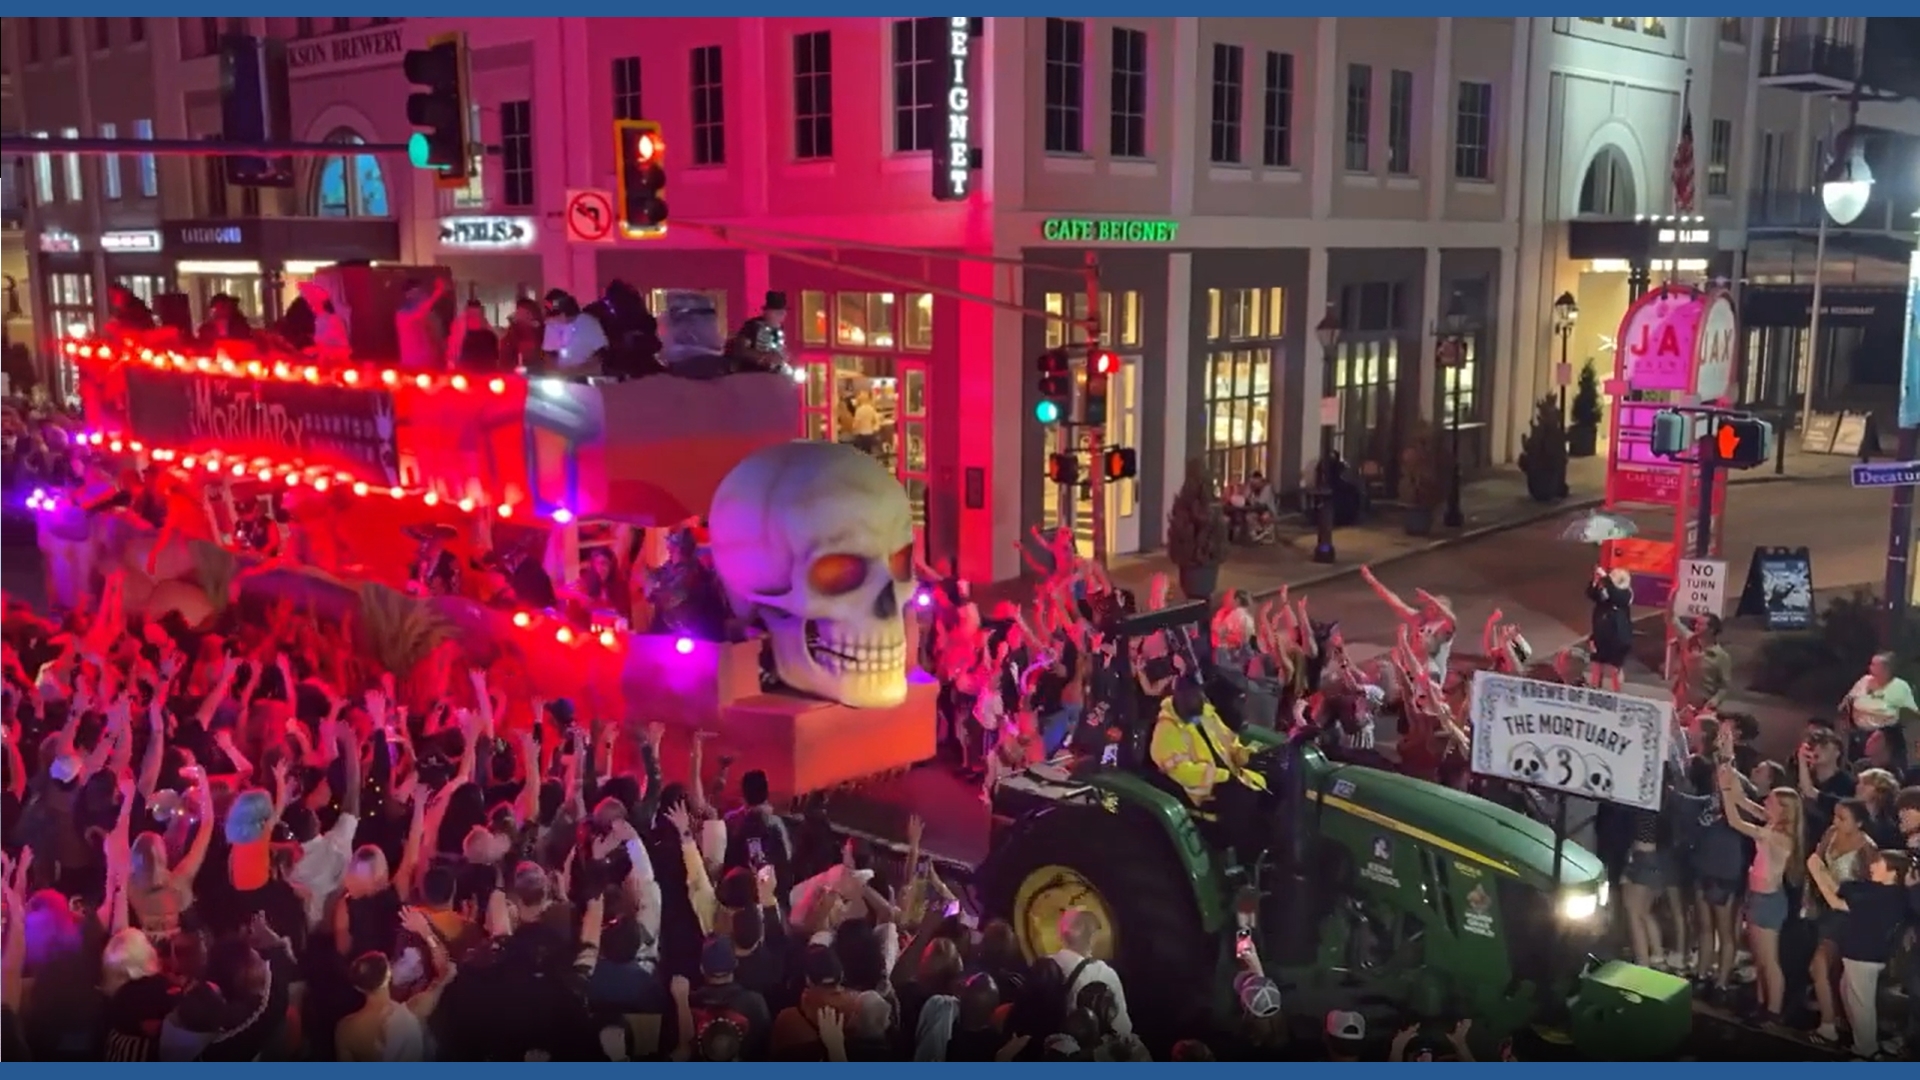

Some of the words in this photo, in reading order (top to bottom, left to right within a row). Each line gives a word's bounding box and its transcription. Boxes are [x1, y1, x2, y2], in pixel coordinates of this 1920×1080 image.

[331, 28, 402, 62] BREWERY
[1043, 219, 1094, 241] CAFE
[1099, 219, 1179, 242] BEIGNET
[194, 376, 303, 447] MORTUARY
[1691, 563, 1714, 577] NO
[1687, 579, 1716, 590] TURN
[1691, 592, 1708, 602] ON
[1688, 604, 1710, 615] RED
[1521, 684, 1565, 701] KREWE
[1568, 688, 1584, 702] OF
[1502, 714, 1536, 737] THE
[1538, 714, 1633, 756] MORTUARY
[1556, 748, 1573, 786] 3
